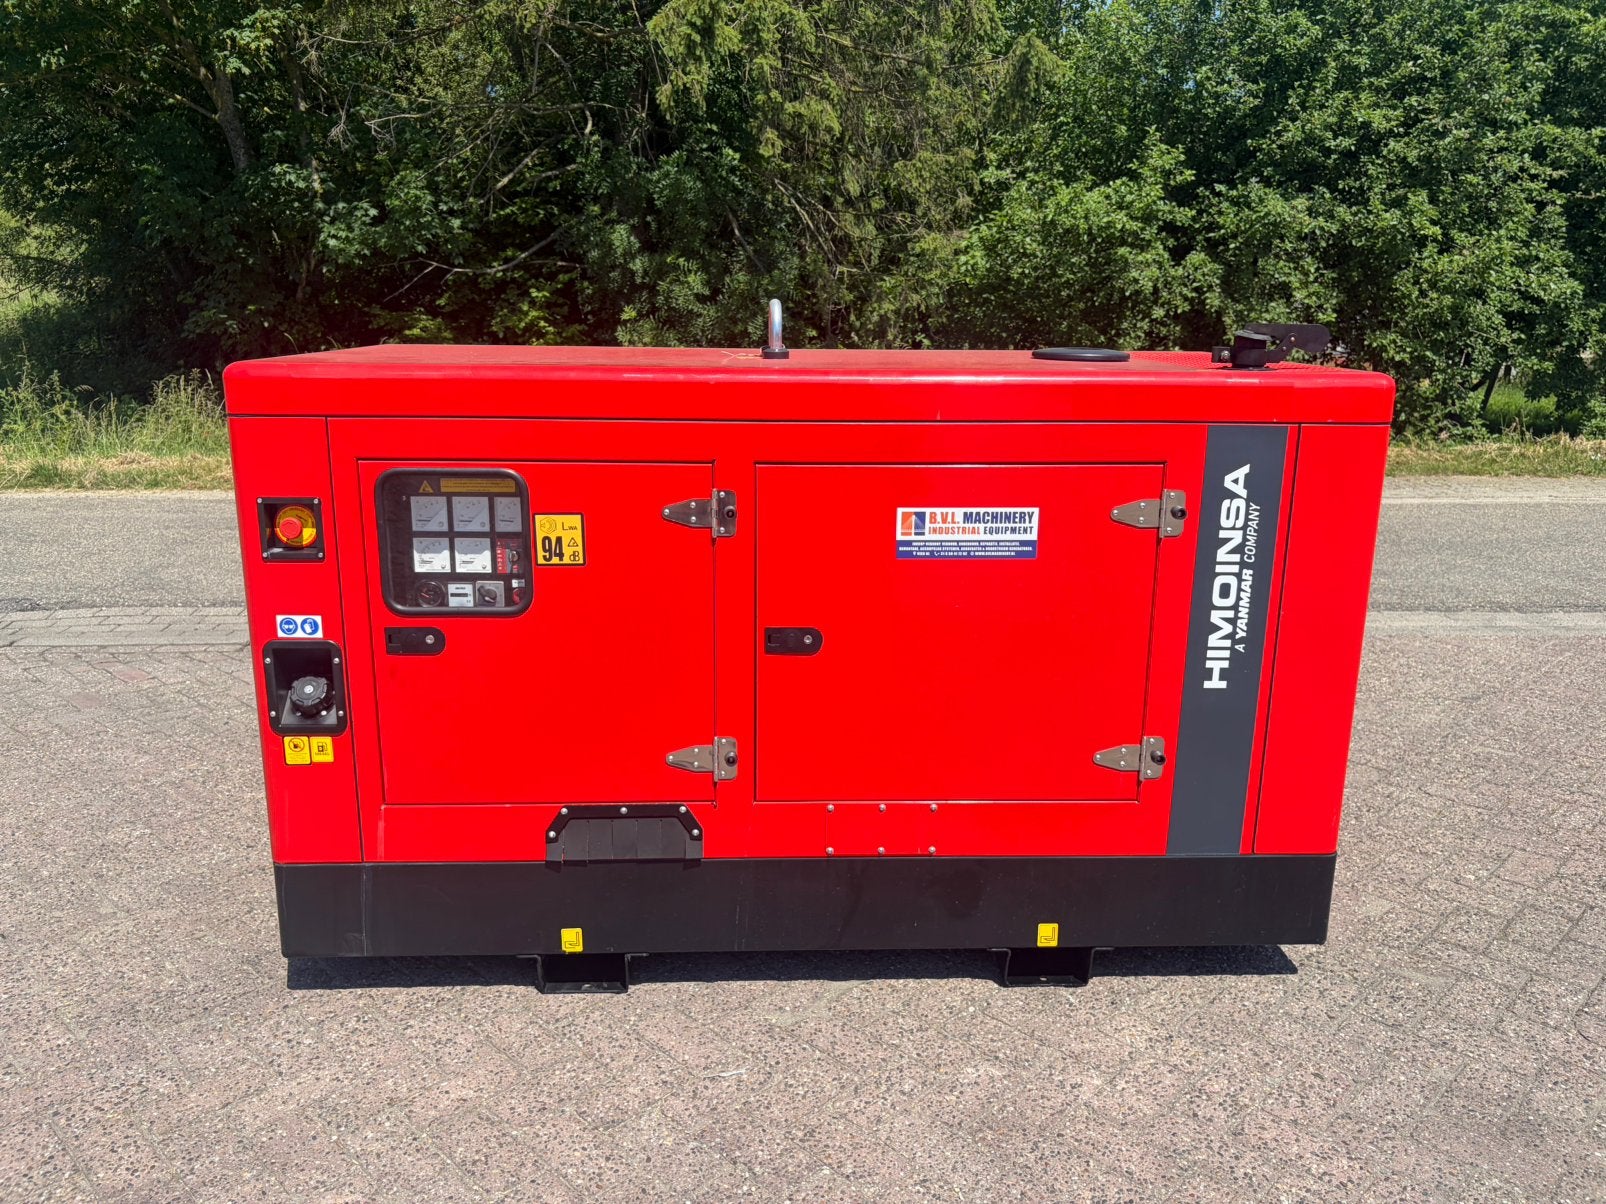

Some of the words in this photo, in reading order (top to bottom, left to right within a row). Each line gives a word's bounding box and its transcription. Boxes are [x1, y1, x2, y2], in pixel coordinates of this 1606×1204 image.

[929, 511, 960, 524] B.V.L.
[962, 511, 1035, 524] MACHINERY
[928, 526, 981, 535] INDUSTRIAL
[983, 526, 1034, 535] EQUIPMENT
[1244, 502, 1261, 563] COMPANY
[541, 535, 565, 562] 94
[569, 550, 581, 562] dB
[1203, 463, 1251, 689] HIMOINSA
[1235, 568, 1254, 640] YANMAR
[1234, 643, 1245, 653] A
